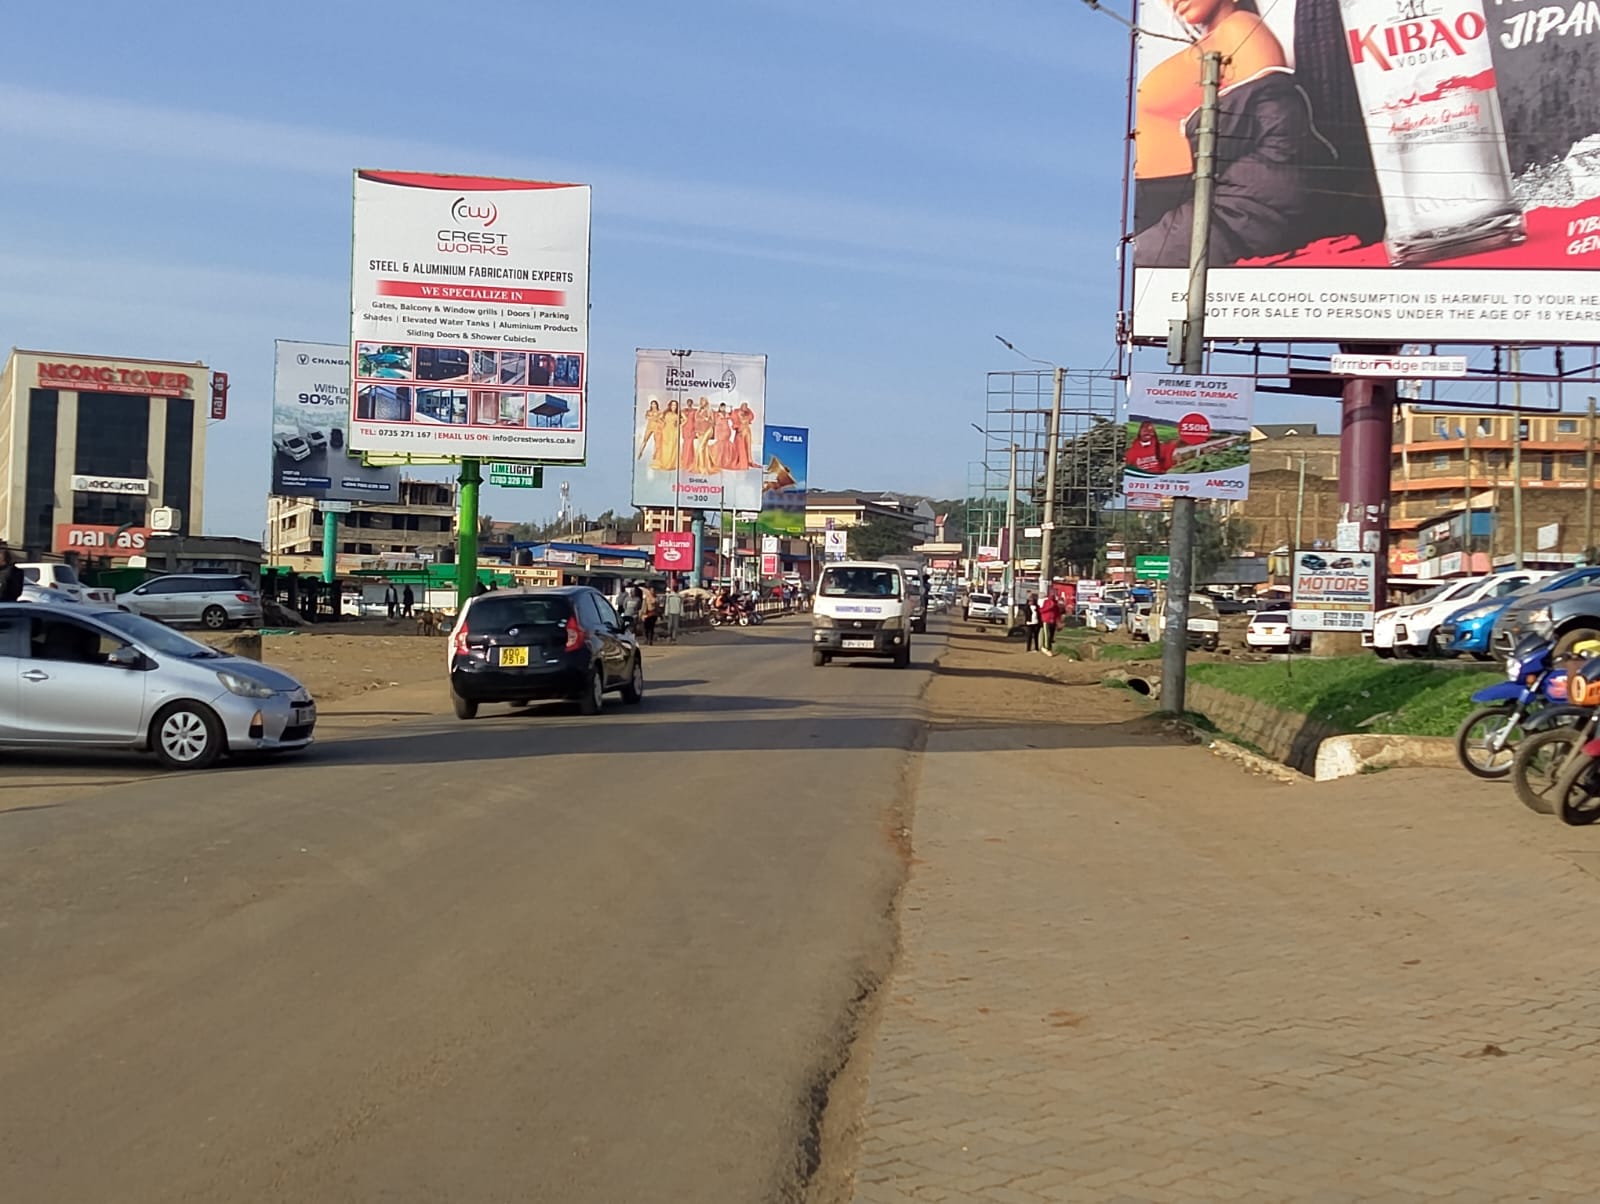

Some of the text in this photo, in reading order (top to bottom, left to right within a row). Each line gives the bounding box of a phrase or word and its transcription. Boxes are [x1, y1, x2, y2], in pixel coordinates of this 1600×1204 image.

[1348, 11, 1487, 71] KIBAO
[1396, 48, 1450, 68] VODKA
[1441, 102, 1480, 124] Quality
[437, 229, 508, 245] CREST
[437, 242, 509, 256] WORKS
[369, 259, 575, 283] STEEL & ALUMINIUM FABRICATION EXPERTS
[421, 286, 524, 301] WE SPECIALIZE IN
[1171, 292, 1246, 303] EXSSIVE
[1250, 292, 1315, 303] ALCOHOL
[1320, 292, 1420, 304] CONSUMPTION
[1425, 294, 1437, 304] IS
[1442, 294, 1509, 305] HARMFUL
[1514, 294, 1532, 305] TO
[1537, 294, 1576, 306] YOUR
[372, 301, 398, 311] Gates,
[400, 303, 432, 313] Balcony
[434, 305, 441, 313] &
[443, 305, 476, 315] Window
[477, 307, 498, 316] grills
[507, 309, 531, 318] Doors
[539, 311, 570, 321] Parking
[1233, 307, 1261, 318] FOR
[1265, 307, 1300, 319] SALE
[1305, 307, 1322, 318] TO
[1327, 307, 1392, 319] PERSONS
[1397, 308, 1444, 320] UNDER
[1448, 309, 1476, 320] THE
[1480, 309, 1509, 320] AGE
[1513, 309, 1532, 320] OF
[1537, 310, 1552, 321] 18
[362, 313, 393, 322] Shades
[402, 315, 438, 325] Elevated
[439, 317, 465, 326] Water
[467, 319, 490, 328] Tanks
[499, 321, 542, 331] Aluminium
[543, 324, 578, 333] Products
[406, 329, 537, 343] Sliding Doors & Shower Cubicles
[38, 362, 113, 382] NGONG
[116, 368, 188, 388] TOWER
[671, 368, 695, 379] Real
[314, 383, 338, 393] With
[665, 377, 731, 389] Housewives
[1158, 379, 1228, 390] PRIME PLOTS
[298, 393, 335, 406] 90%
[1146, 388, 1239, 400] TOUCHING TARMAC
[1181, 422, 1209, 432] 550K
[360, 428, 377, 436] TEL:
[378, 429, 398, 437] 0735
[400, 430, 414, 438] 271
[417, 431, 431, 439] 167
[464, 433, 475, 441] US
[492, 434, 576, 445] info@crestworks.co.ke
[783, 435, 803, 443] NCBA
[491, 463, 533, 475] LIMELIGHT
[1128, 481, 1151, 490] 0701
[1153, 483, 1171, 491] 293
[694, 494, 708, 502] 300
[69, 524, 145, 549] naivas
[1297, 576, 1369, 591] MOTORS
